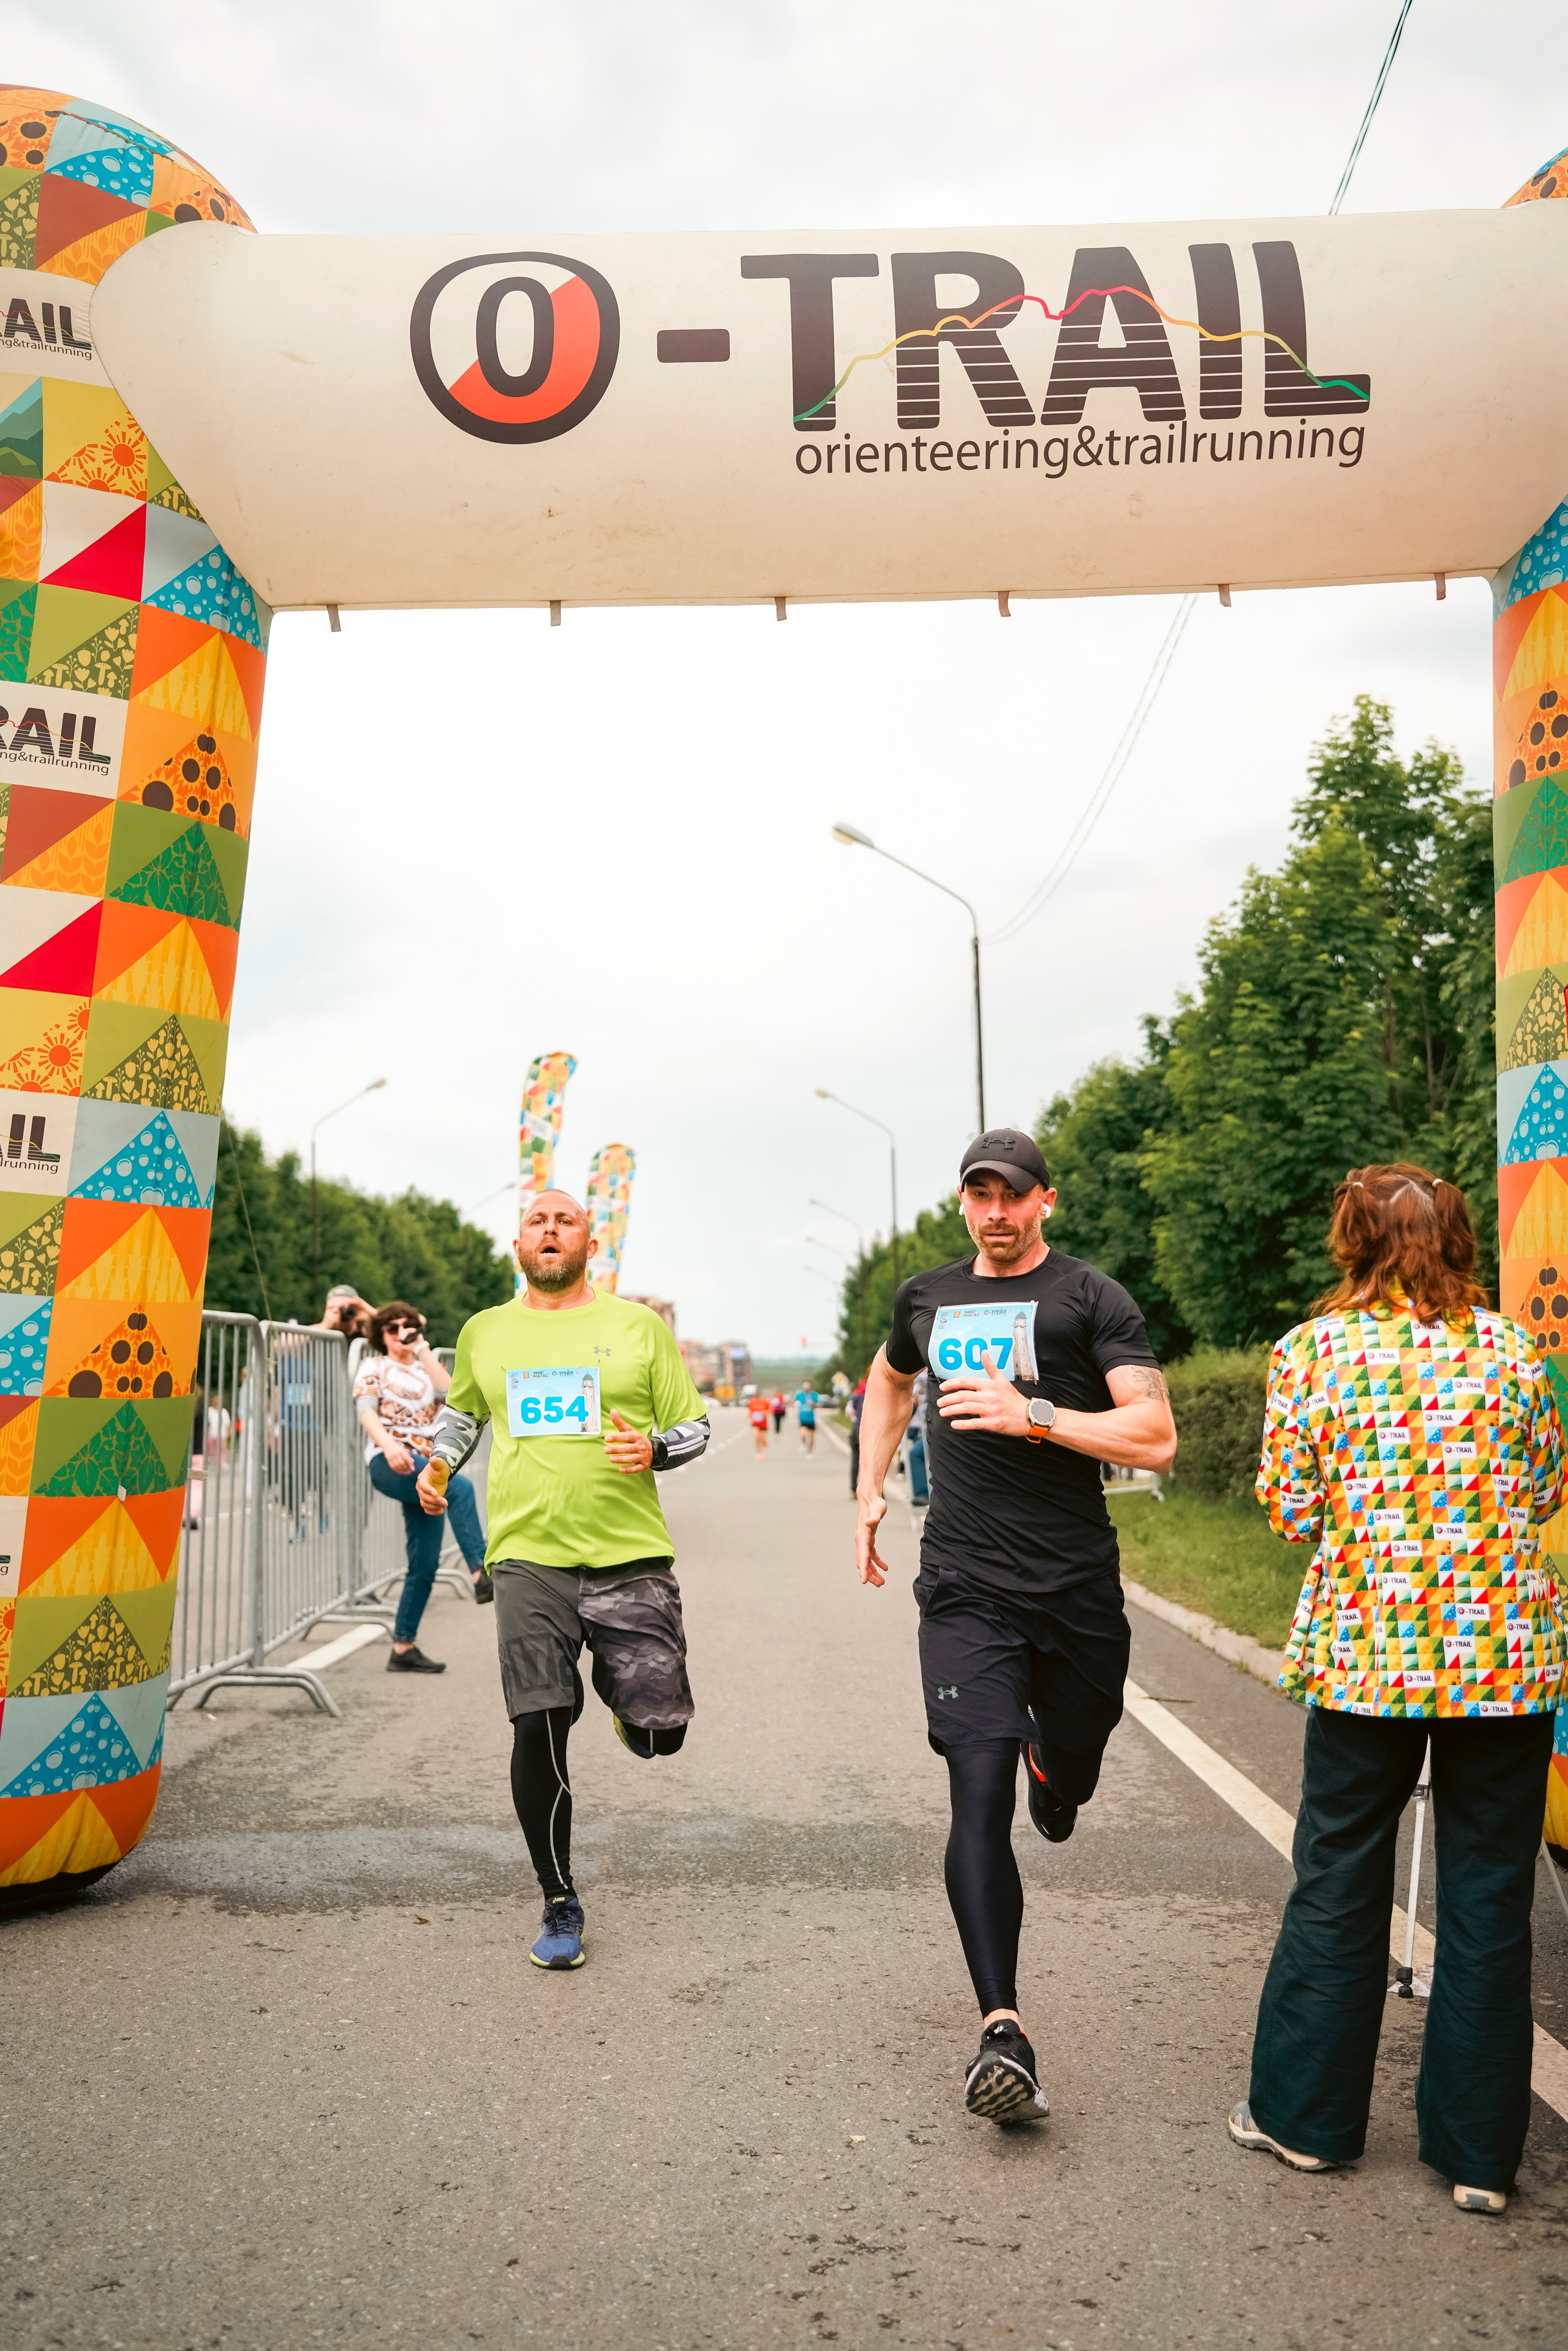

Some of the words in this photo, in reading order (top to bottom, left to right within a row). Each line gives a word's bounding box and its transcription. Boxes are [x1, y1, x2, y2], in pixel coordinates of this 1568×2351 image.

[0, 298, 92, 350] AIL
[796, 424, 1365, 478] orienteering&trailrunning
[0, 706, 111, 764] AIL
[939, 1338, 1013, 1370] 607
[521, 1396, 589, 1424] 654
